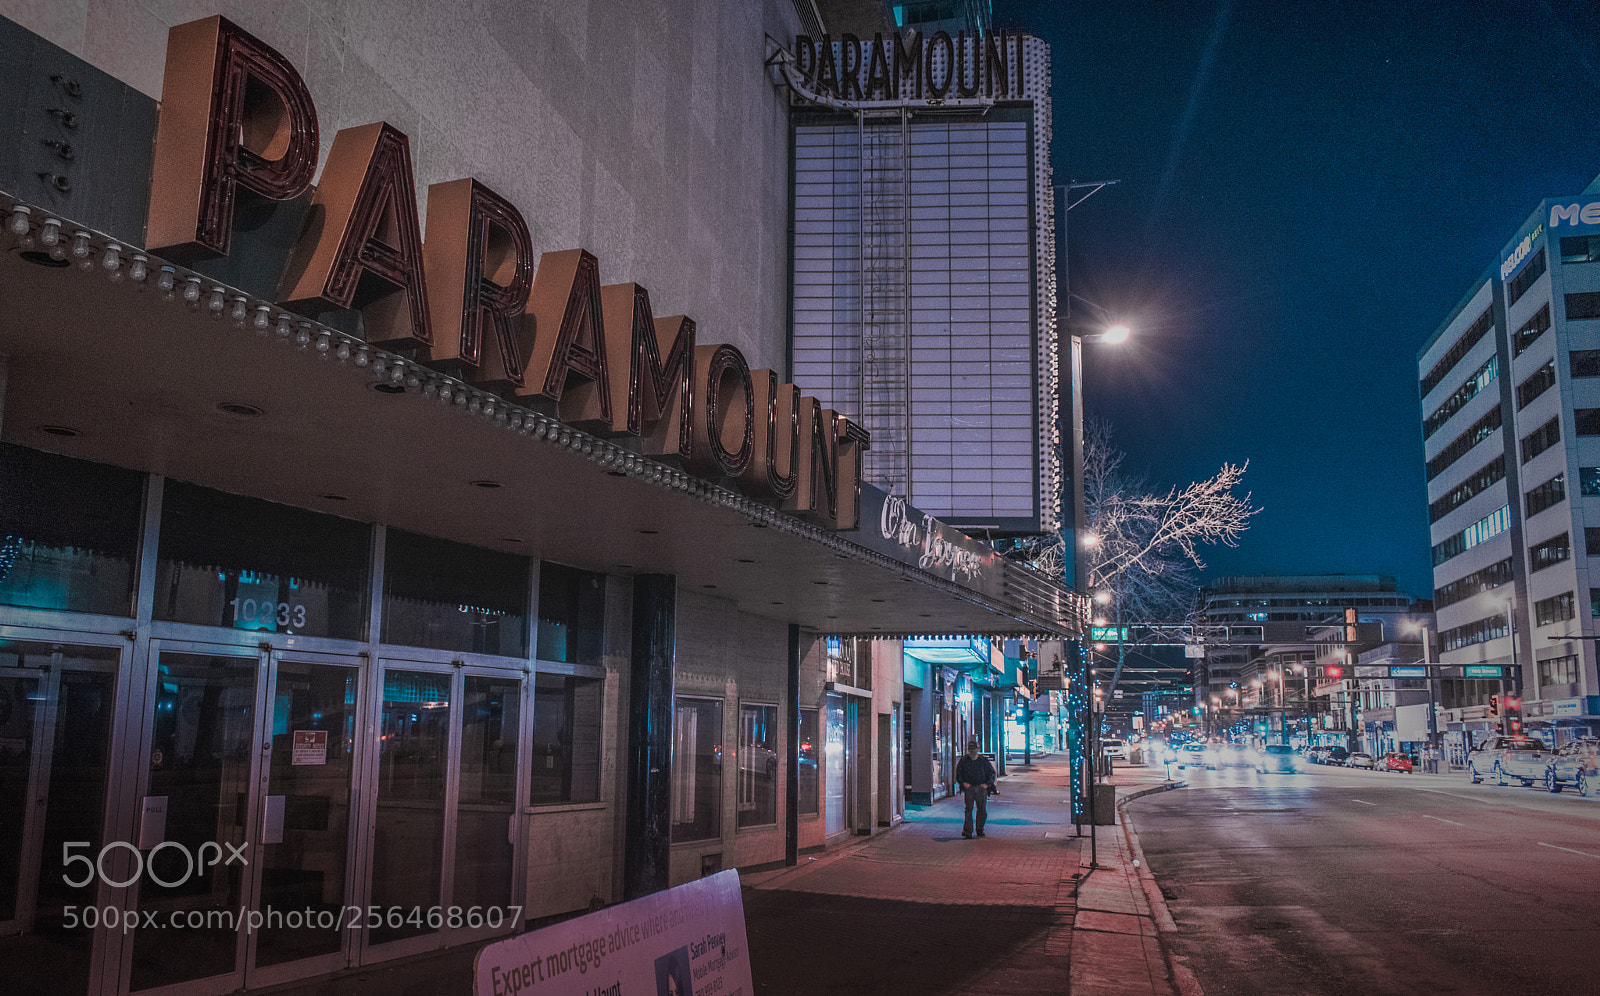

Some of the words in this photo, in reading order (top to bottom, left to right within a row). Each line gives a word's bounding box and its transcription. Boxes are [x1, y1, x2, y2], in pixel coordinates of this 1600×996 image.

[796, 28, 1027, 100] PARAMOUNT
[145, 14, 870, 532] PARAMOUNT
[230, 598, 307, 628] 10233
[491, 956, 544, 996] Expert
[546, 936, 606, 975] mortgage
[608, 919, 640, 951] advice
[641, 912, 668, 940] where
[691, 936, 708, 960] Sarah
